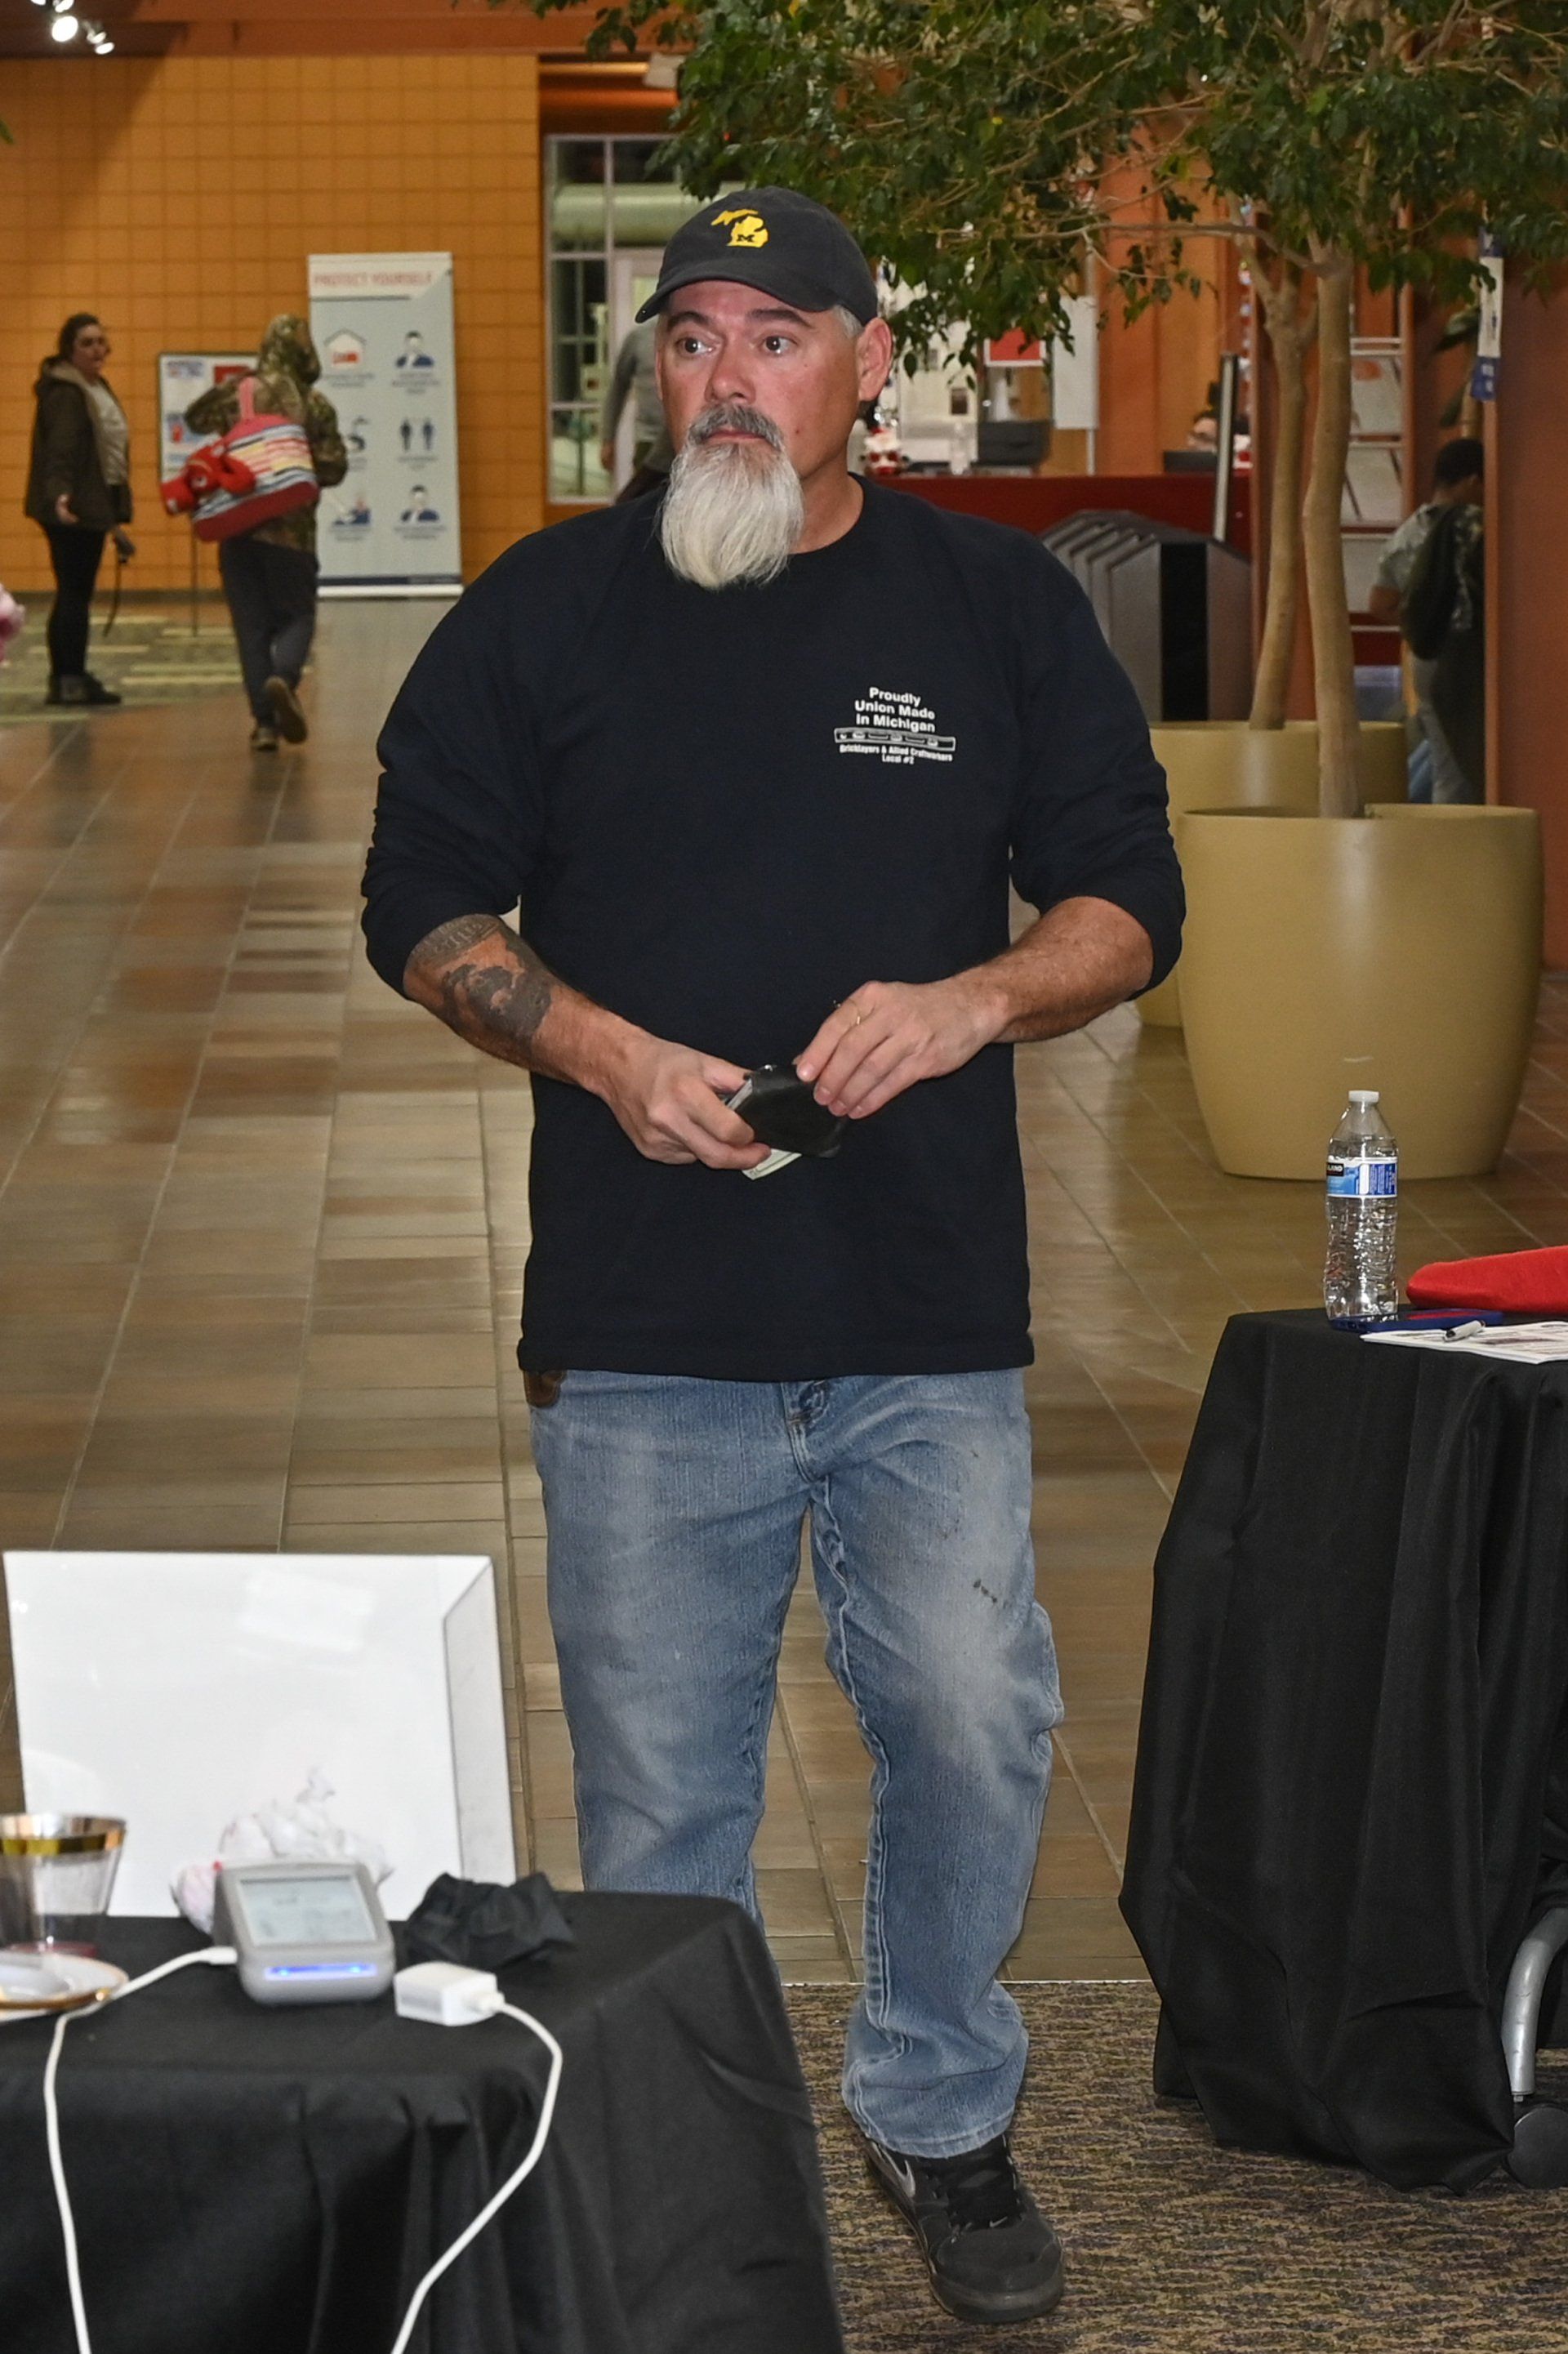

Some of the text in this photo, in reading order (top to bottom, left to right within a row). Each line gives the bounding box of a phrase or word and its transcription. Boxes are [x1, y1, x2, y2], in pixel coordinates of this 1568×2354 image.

[737, 234, 755, 243] M
[869, 686, 921, 707] Proudly
[854, 700, 935, 720] Union Made
[873, 715, 936, 733] Michigan
[889, 746, 909, 756] Allied
[882, 754, 902, 763] Local
